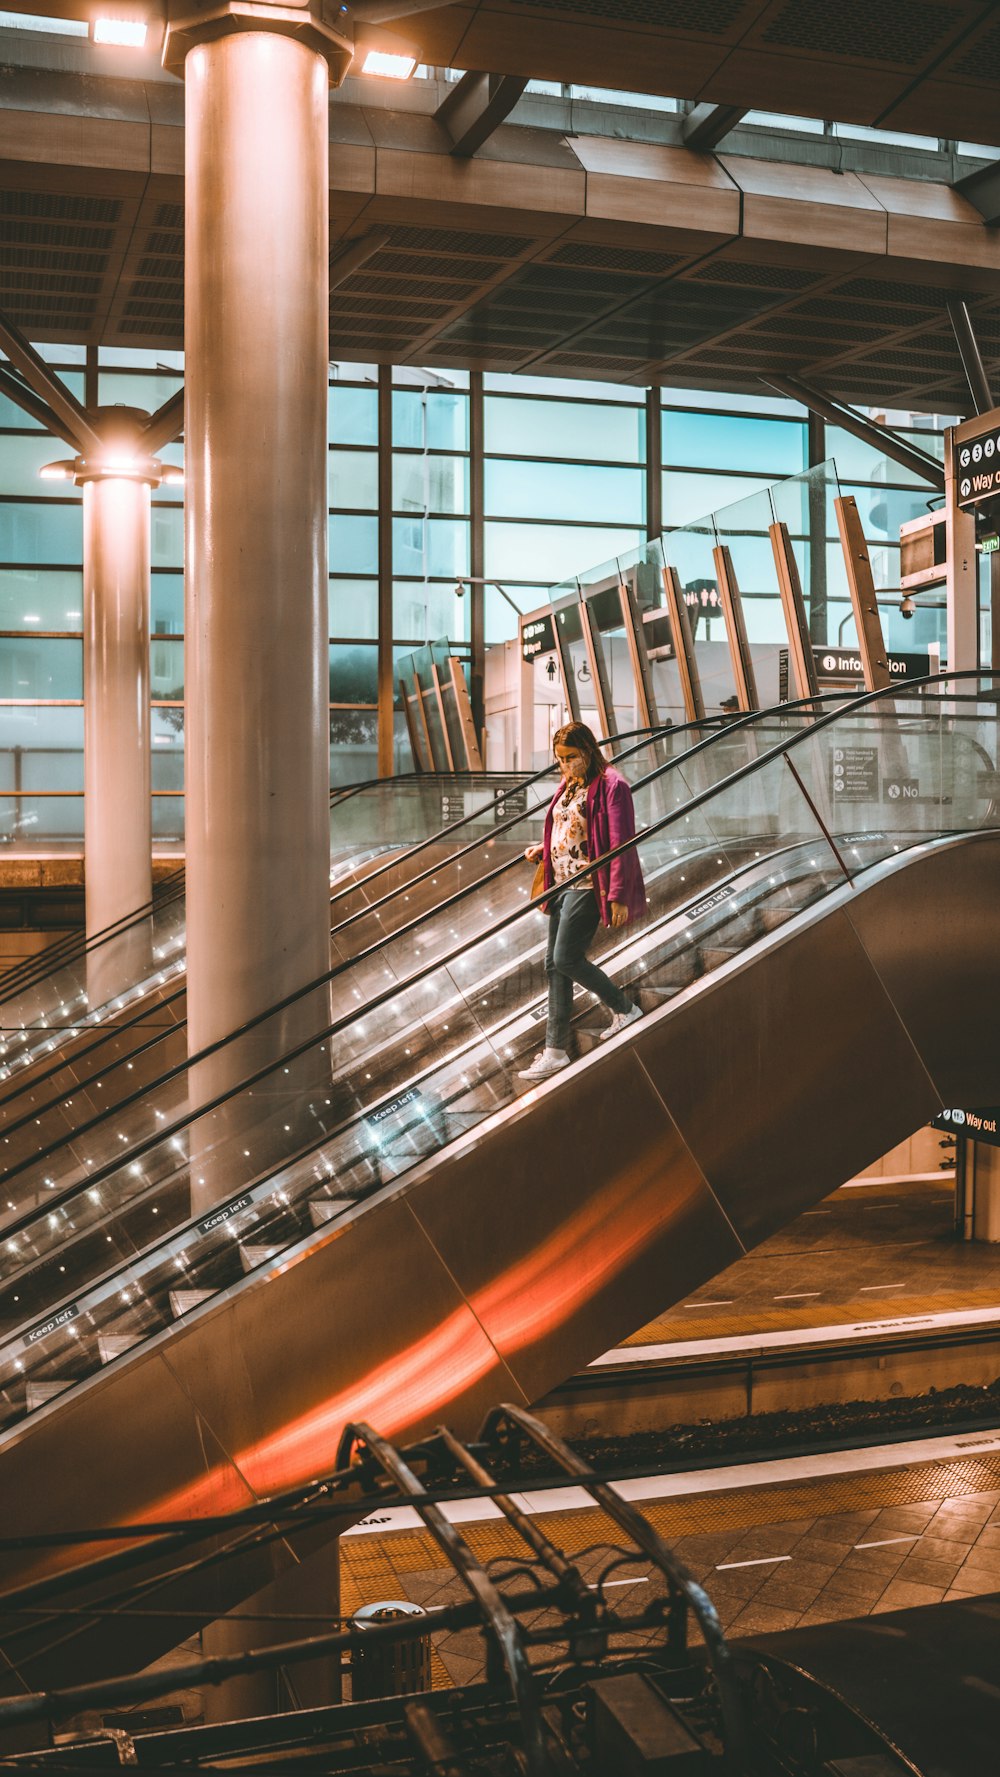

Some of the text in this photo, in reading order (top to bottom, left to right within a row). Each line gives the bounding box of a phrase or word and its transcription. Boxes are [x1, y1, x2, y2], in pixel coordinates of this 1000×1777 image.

[973, 474, 994, 492] Way
[838, 657, 907, 673] Infoion
[902, 785, 919, 798] No
[691, 889, 731, 916] Keep left
[373, 1092, 416, 1121] Keep left
[966, 1112, 997, 1132] Way out
[203, 1200, 248, 1230] Keep left
[29, 1310, 74, 1341] Keep left
